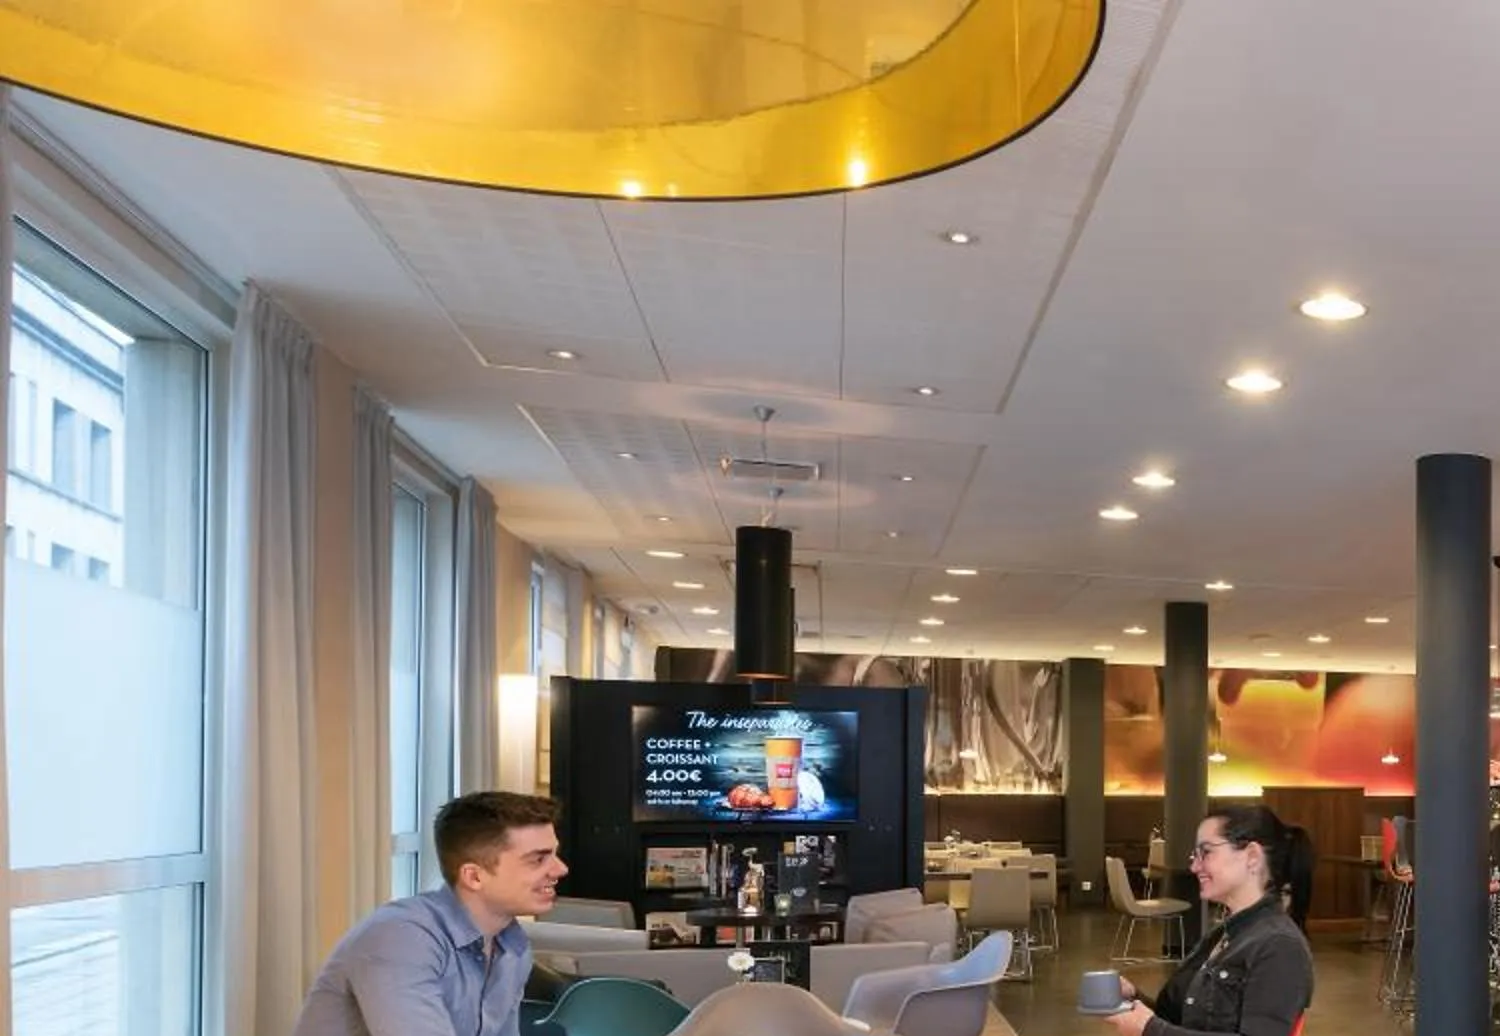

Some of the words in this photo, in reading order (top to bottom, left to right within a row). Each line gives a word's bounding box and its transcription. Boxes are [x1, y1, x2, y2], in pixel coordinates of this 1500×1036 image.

[686, 711, 718, 728] The
[646, 738, 701, 750] COFFEE
[646, 753, 720, 765] CROISSANT
[645, 769, 702, 783] 4.00€
